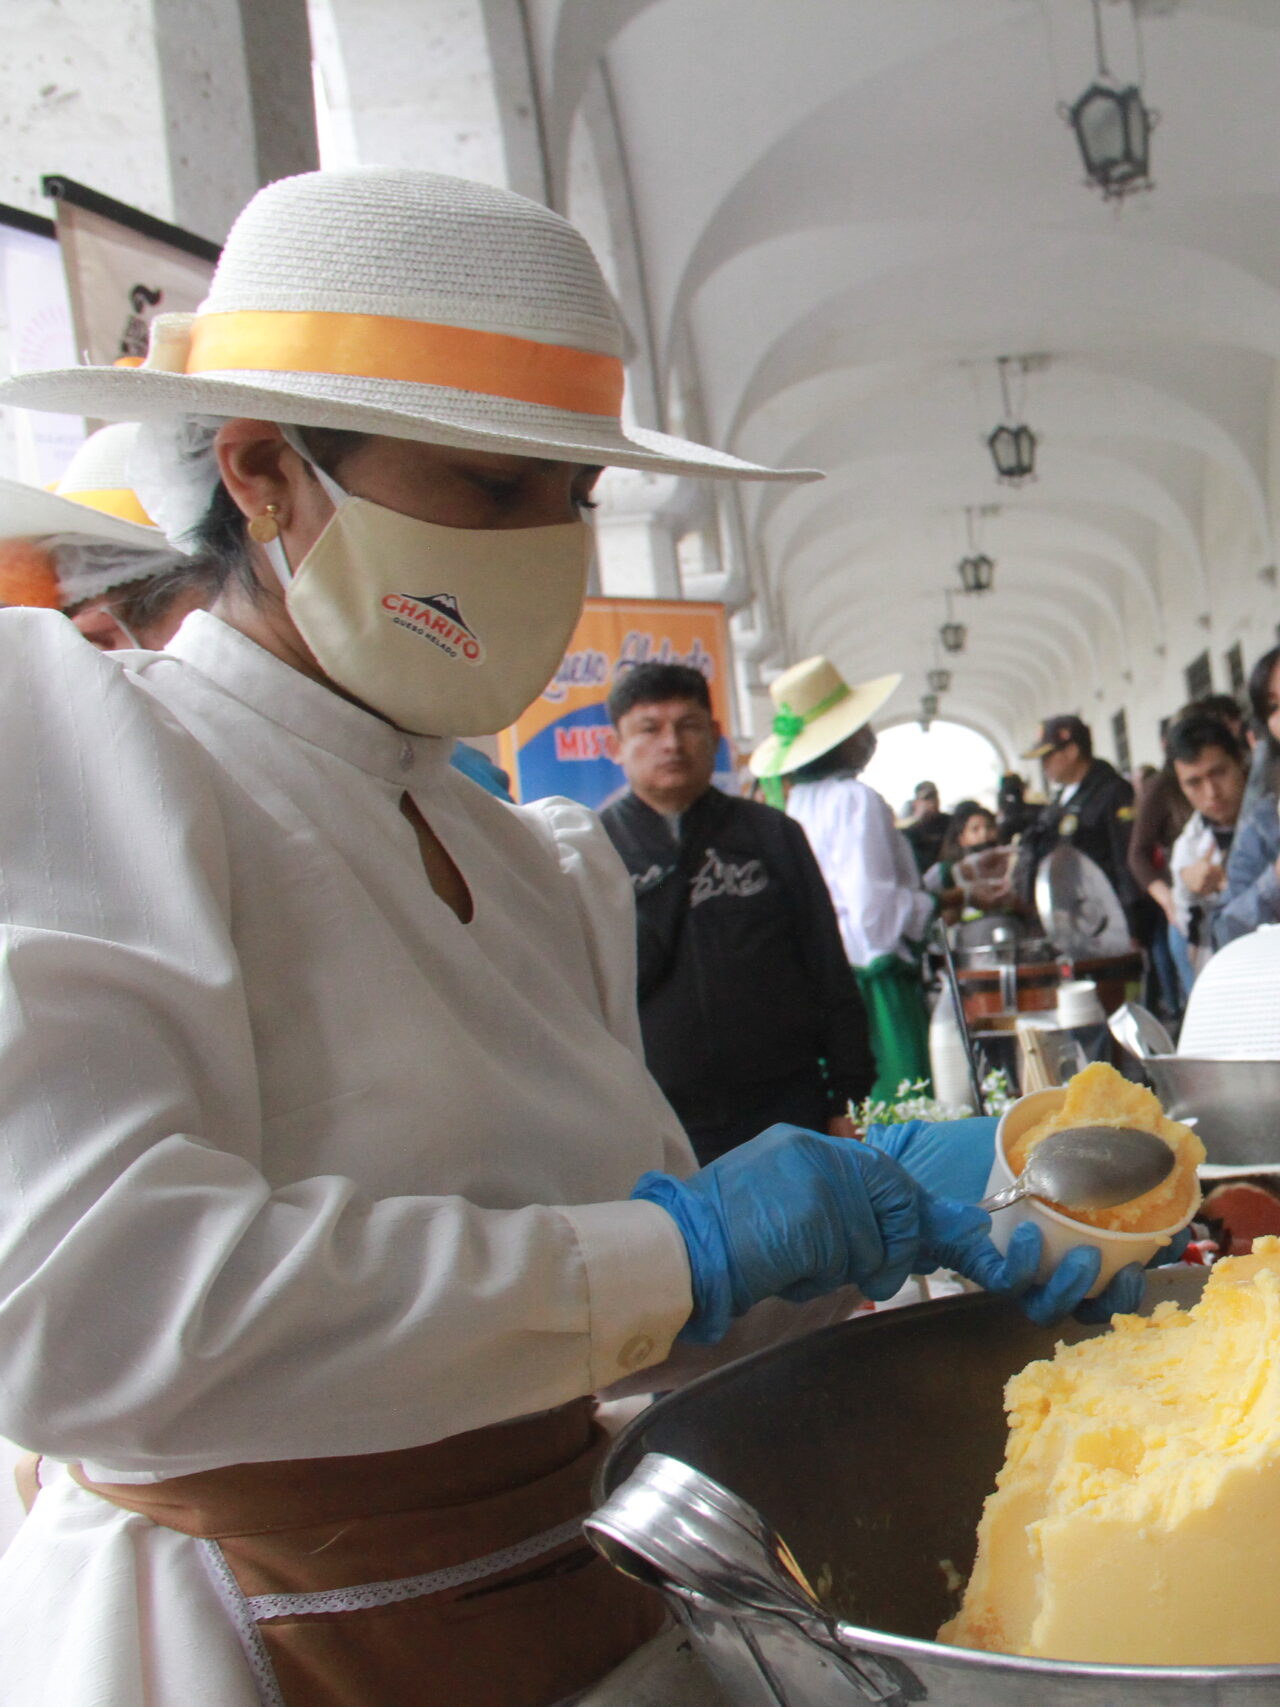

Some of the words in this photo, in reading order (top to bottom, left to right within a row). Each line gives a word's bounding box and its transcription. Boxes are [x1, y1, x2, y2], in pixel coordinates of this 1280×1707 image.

[381, 593, 480, 660] CHARITO
[393, 616, 424, 636] QUESO
[543, 650, 607, 701] ueso
